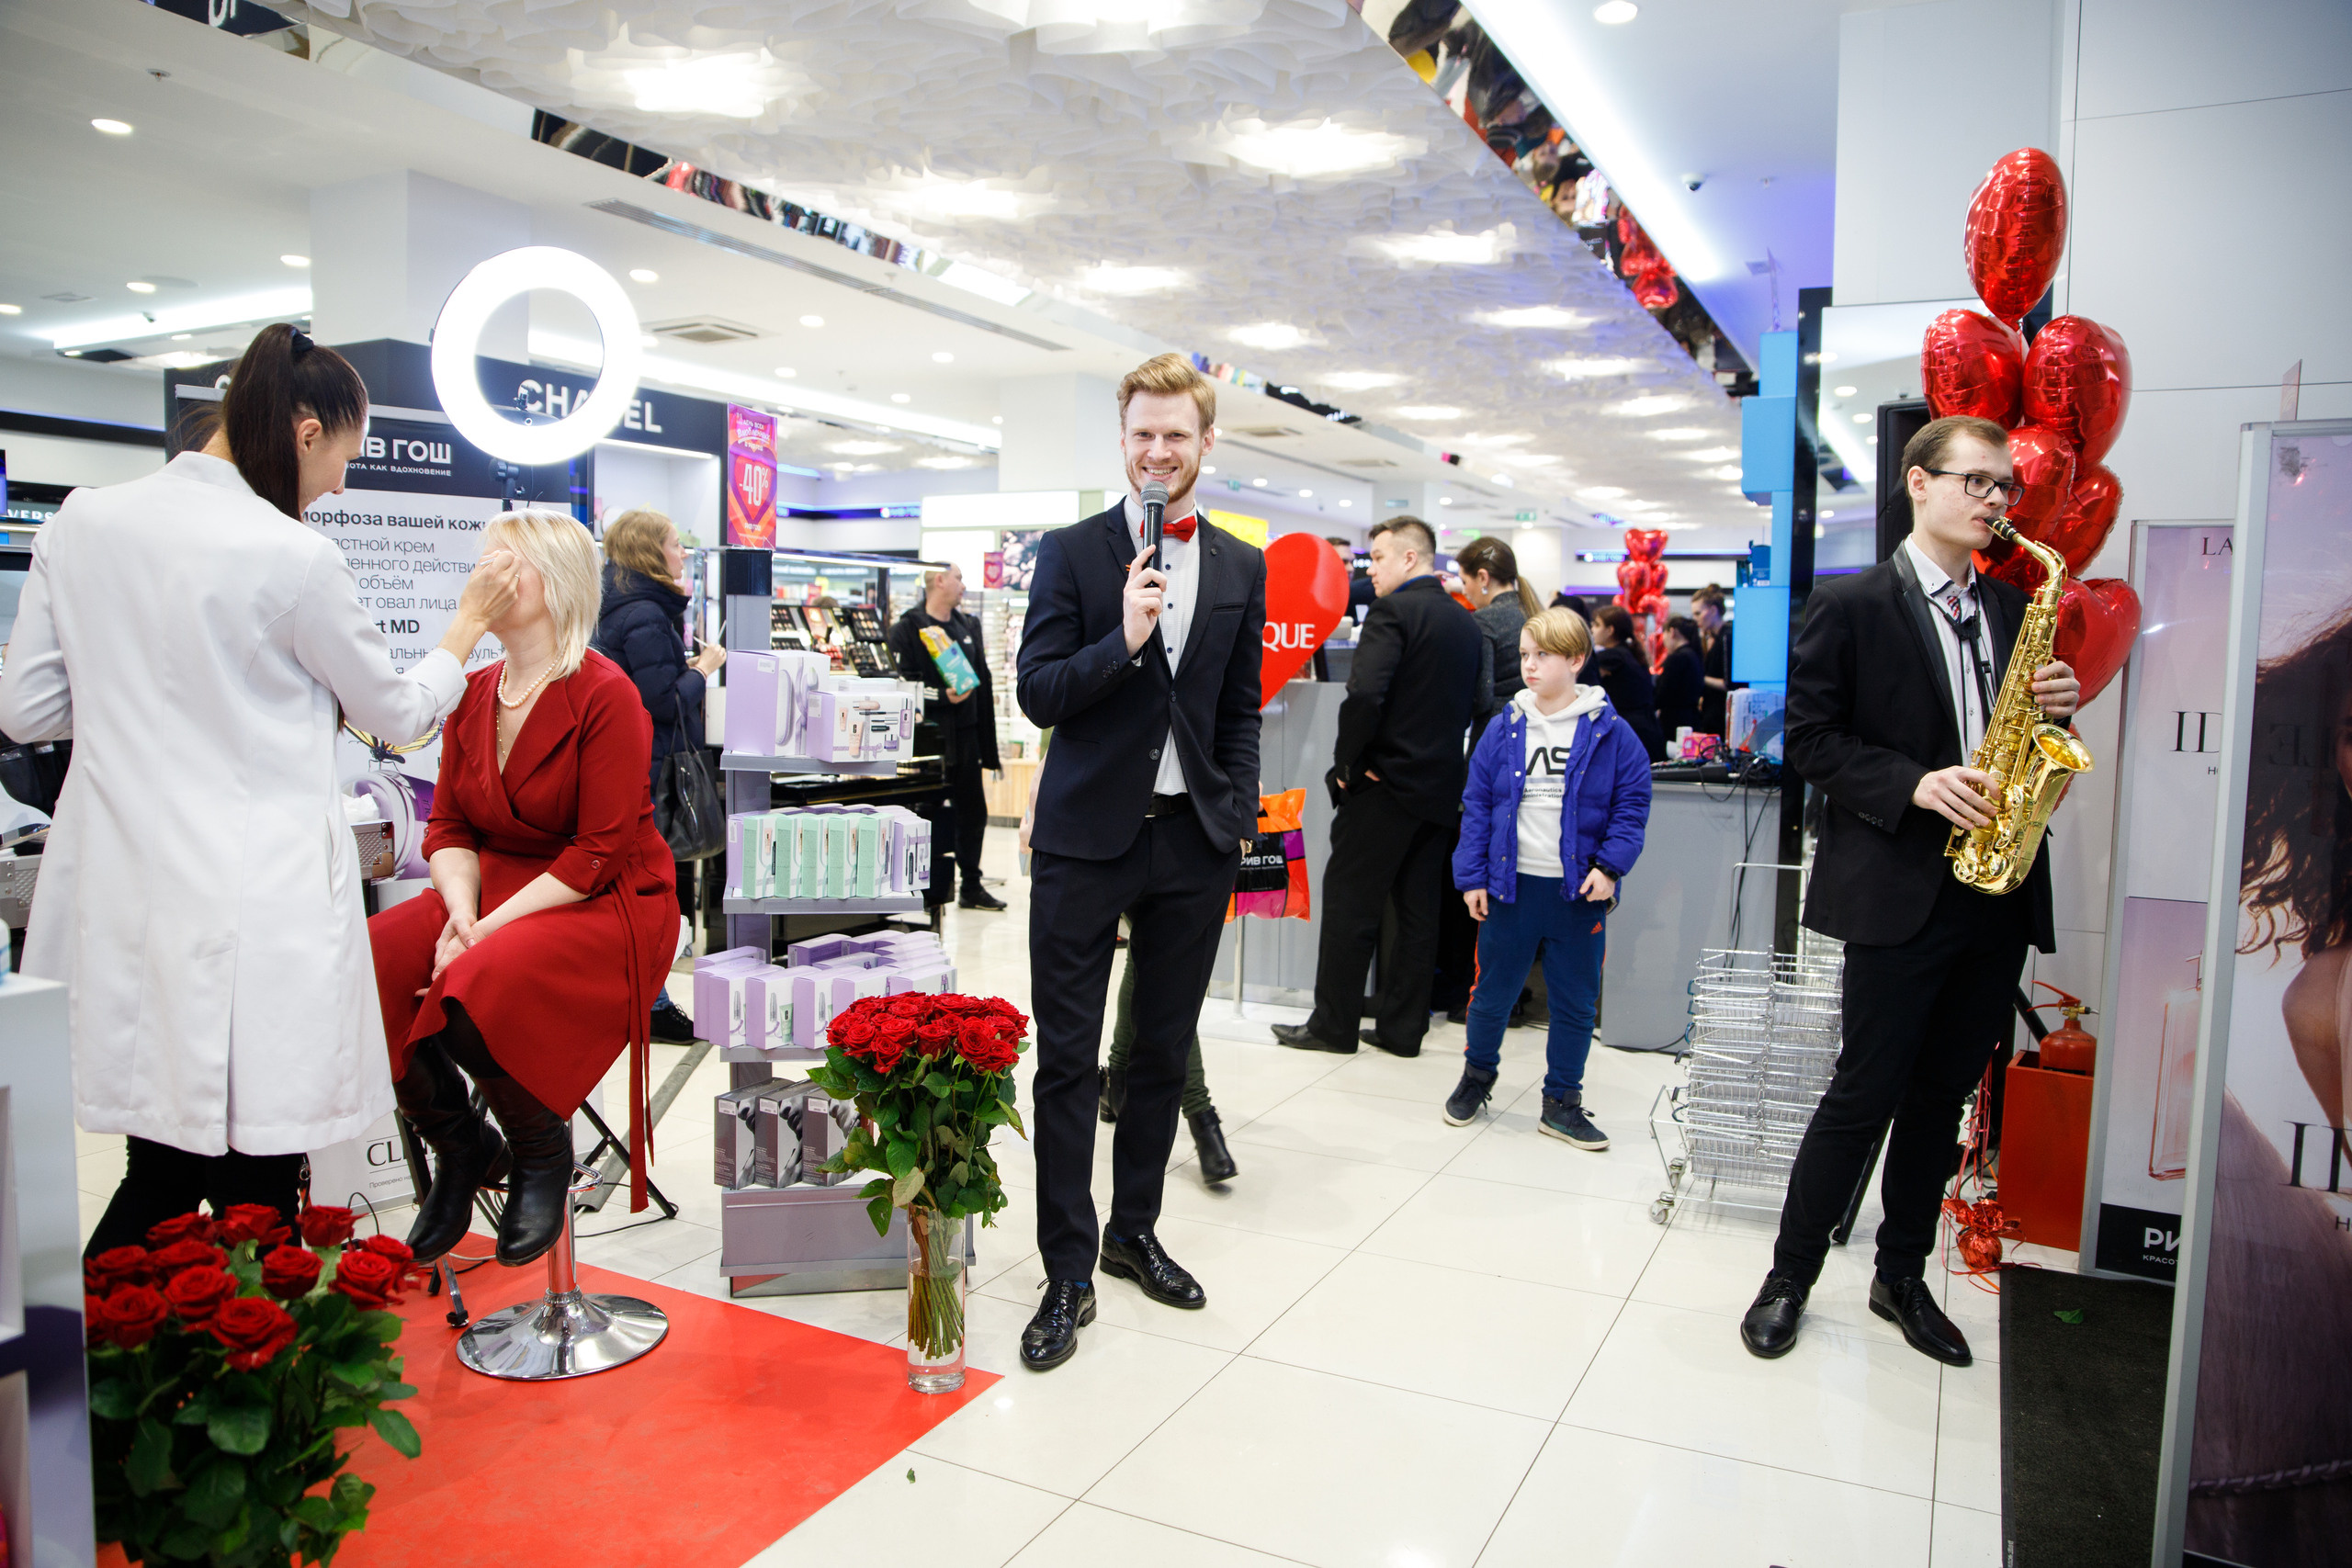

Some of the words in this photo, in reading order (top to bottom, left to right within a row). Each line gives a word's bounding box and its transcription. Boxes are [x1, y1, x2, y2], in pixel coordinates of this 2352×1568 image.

[392, 438, 452, 465] ГОШ
[347, 462, 368, 470] ОТА
[369, 463, 388, 471] КАК
[390, 466, 452, 477] ВДОХНОВЕНИЕ
[387, 515, 444, 530] вашей
[448, 518, 486, 532] кож
[394, 541, 435, 555] крем
[358, 575, 413, 591] объём
[376, 597, 414, 609] овал
[418, 598, 458, 612] лица
[390, 619, 420, 634] MD
[1262, 854, 1283, 865] ГОШ
[369, 1177, 403, 1188] Проверено
